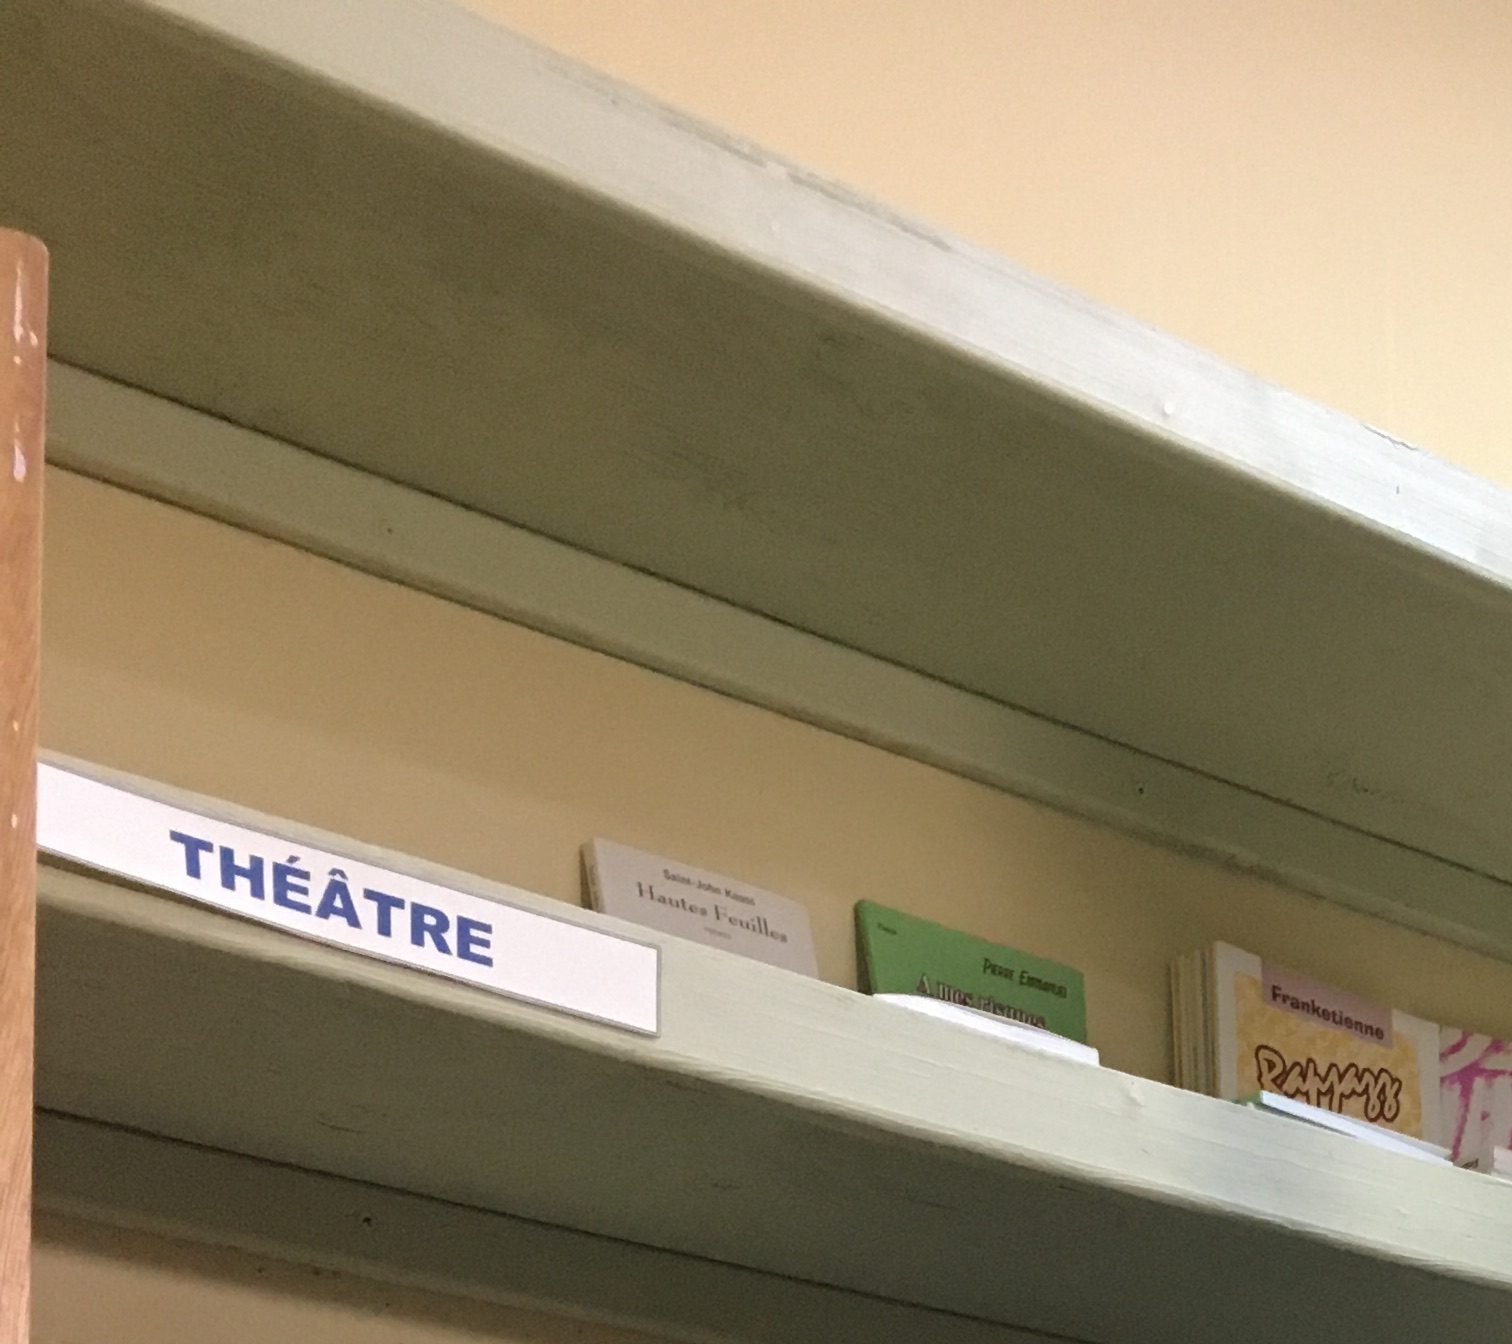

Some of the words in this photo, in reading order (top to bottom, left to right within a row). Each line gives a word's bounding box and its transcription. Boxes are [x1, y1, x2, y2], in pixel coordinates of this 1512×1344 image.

[169, 829, 494, 967] THÉÂTRE
[636, 881, 708, 917] Hautes
[713, 904, 788, 943] Feuilles
[1271, 984, 1384, 1040] Franketienne
